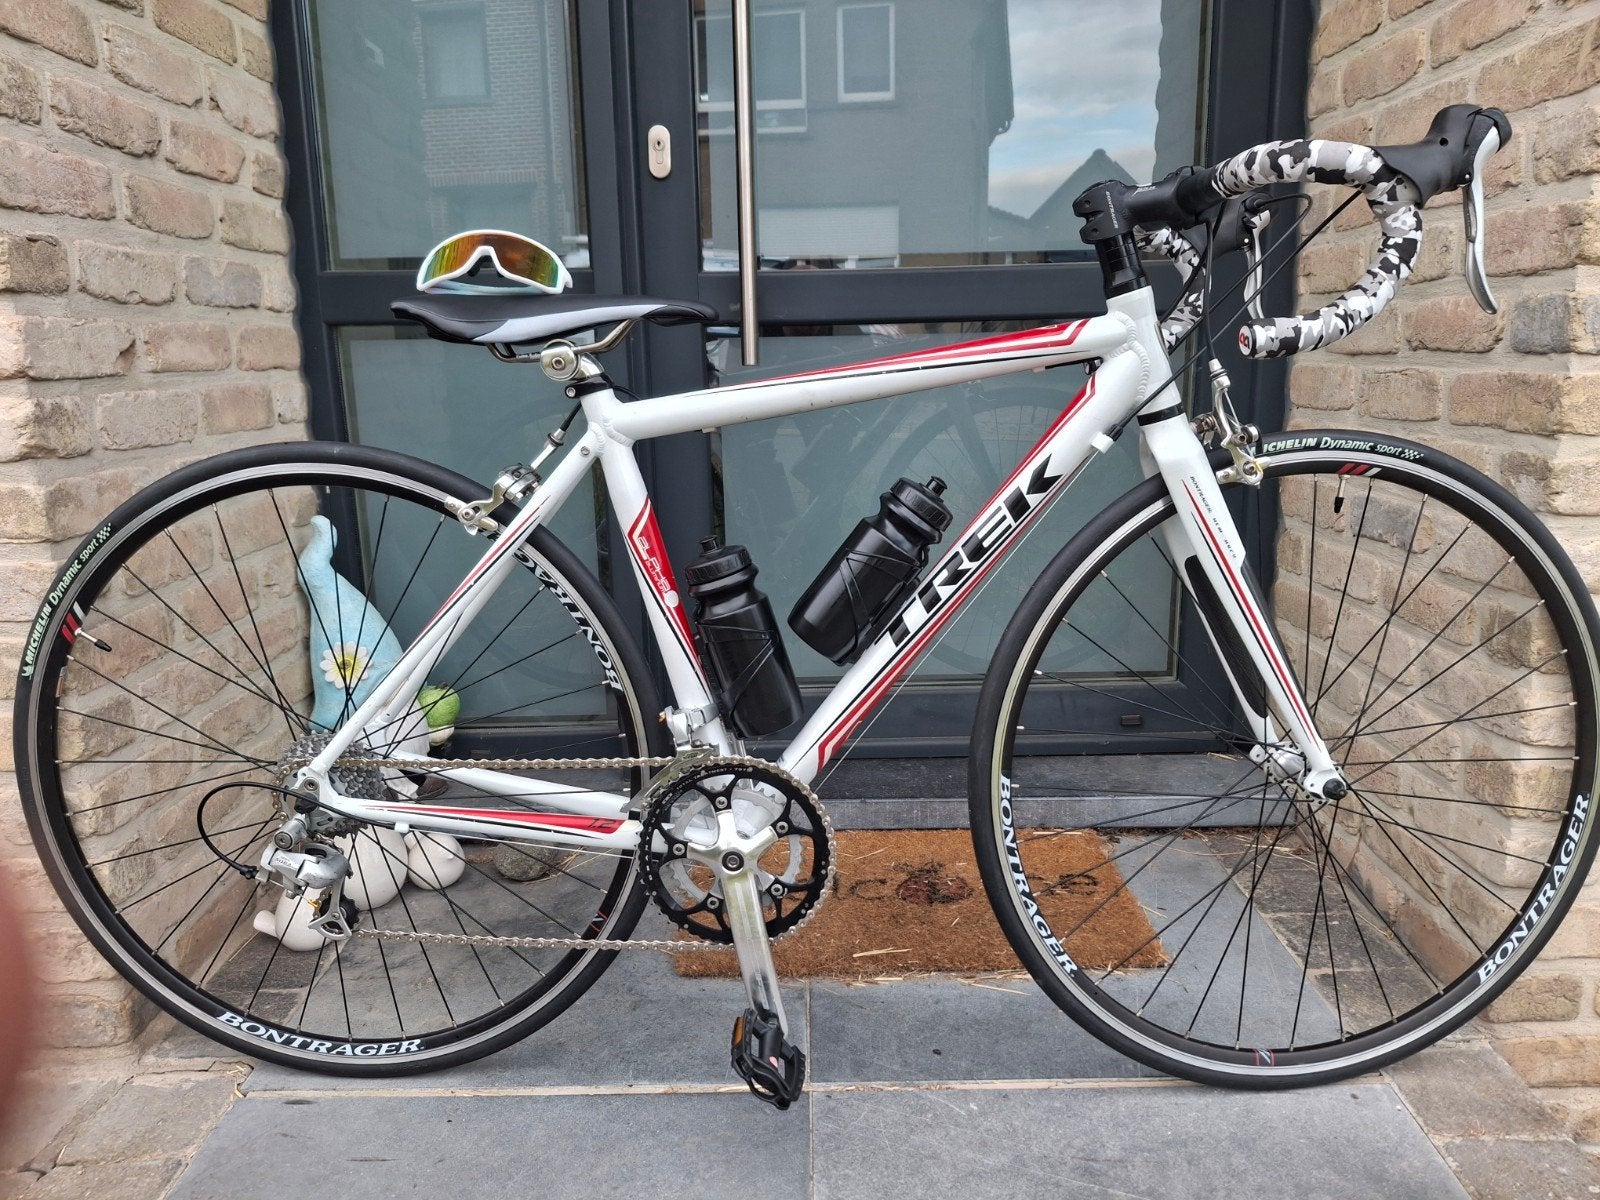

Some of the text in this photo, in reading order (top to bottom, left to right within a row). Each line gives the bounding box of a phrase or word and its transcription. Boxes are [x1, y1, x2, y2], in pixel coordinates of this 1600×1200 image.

[1106, 191, 1119, 229] BONTRAGER
[1319, 437, 1375, 451] Dynamic
[1374, 443, 1402, 456] sport
[25, 537, 99, 665] MICHELIN Dynamic sport
[873, 453, 1064, 647] TREK
[512, 548, 624, 692] BONTRAG
[587, 817, 617, 829] 1.2
[1000, 773, 1079, 977] BONTRAGER
[1478, 793, 1591, 986] BONTRAGER
[216, 1011, 423, 1056] BONTRAGER
